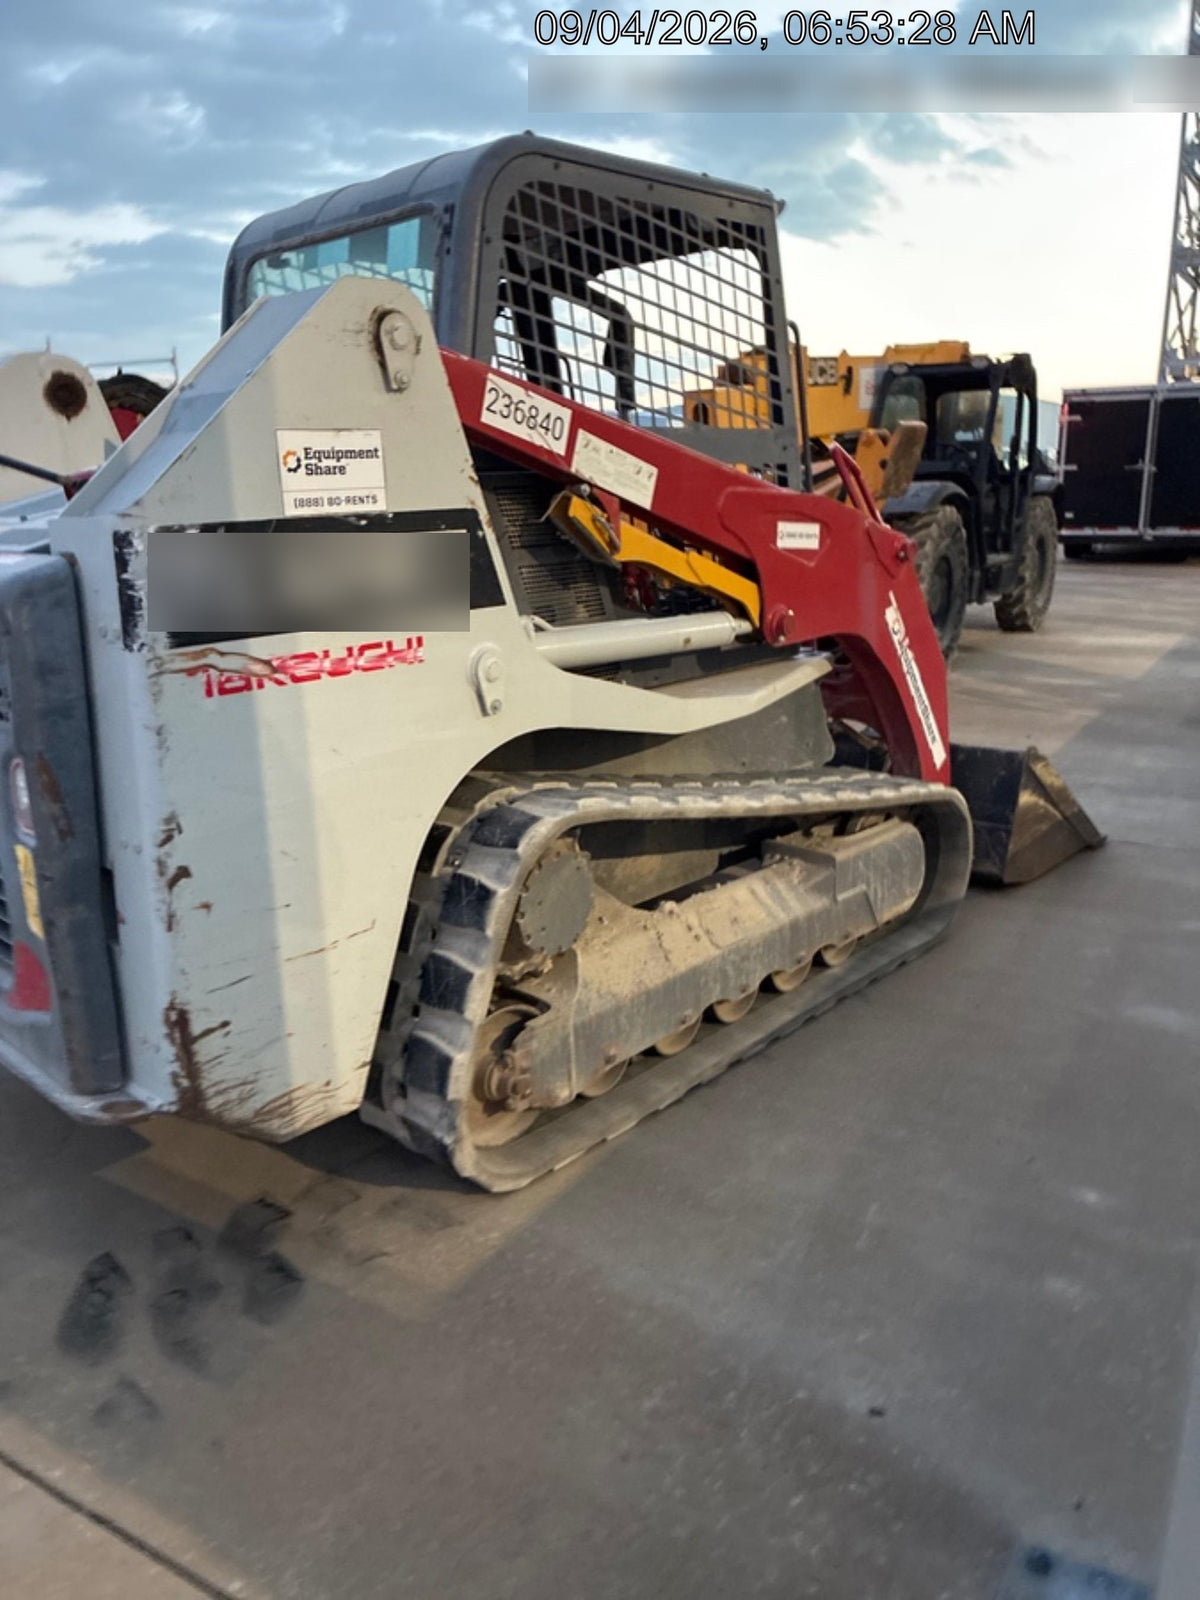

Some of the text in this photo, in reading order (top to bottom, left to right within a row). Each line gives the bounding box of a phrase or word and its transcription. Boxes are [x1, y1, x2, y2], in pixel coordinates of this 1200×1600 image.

[486, 386, 565, 441] 236840
[303, 446, 380, 462] Equipment
[304, 463, 347, 476] Share
[293, 497, 325, 509] (888)
